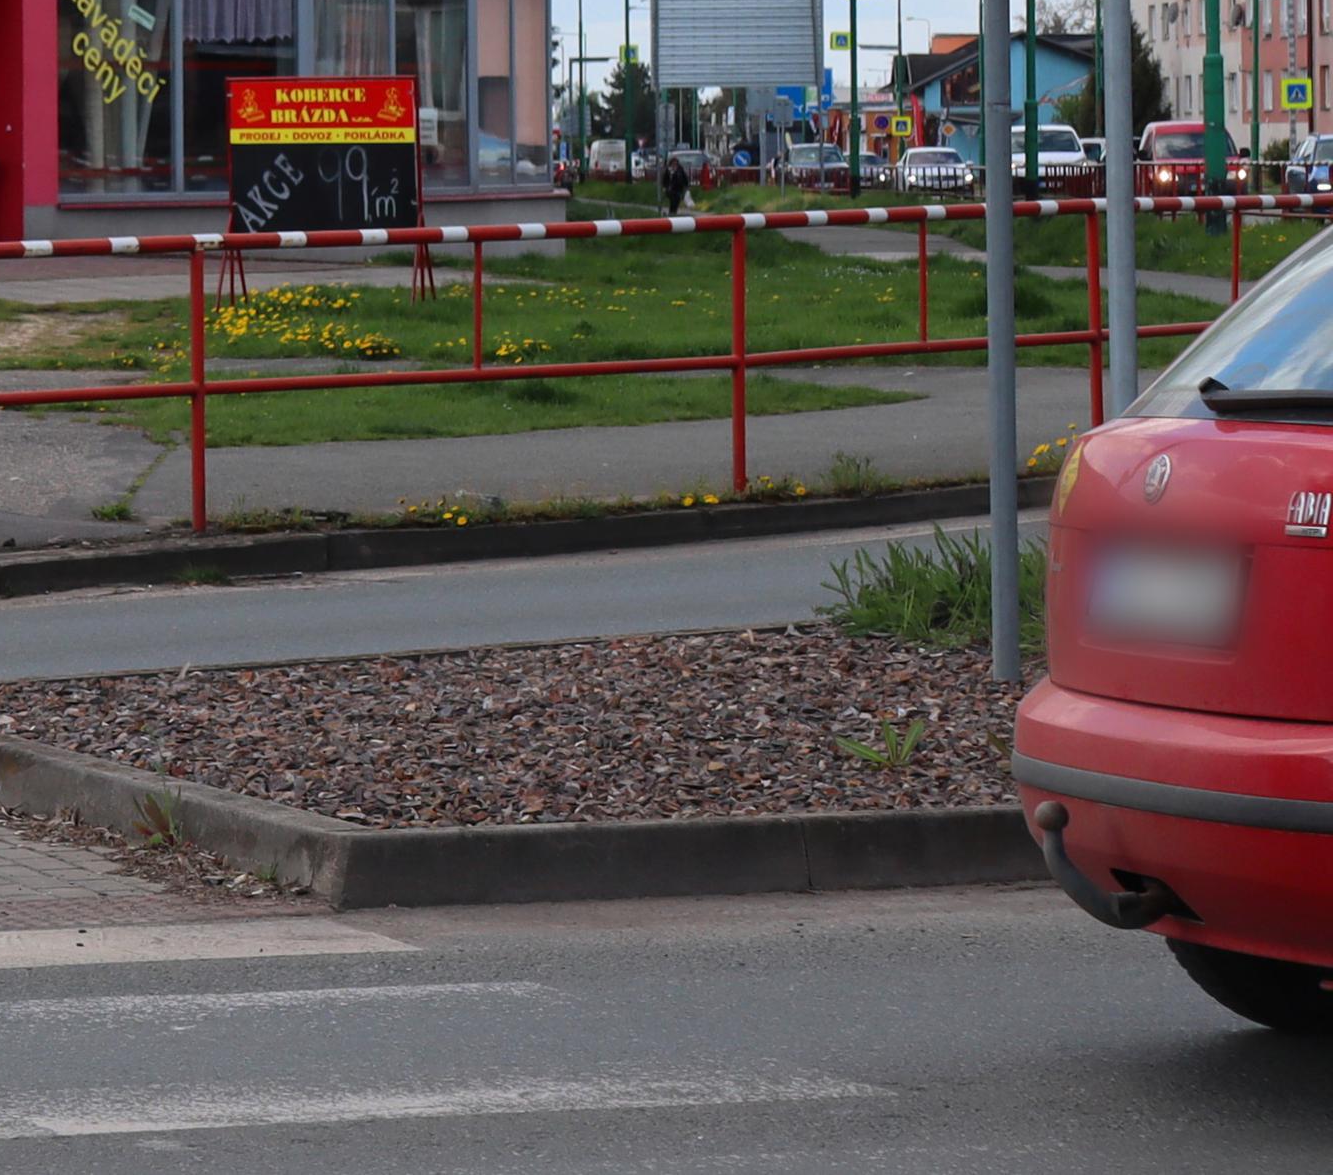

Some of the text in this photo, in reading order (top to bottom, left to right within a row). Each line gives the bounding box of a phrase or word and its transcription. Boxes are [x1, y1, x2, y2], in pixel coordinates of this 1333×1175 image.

[72, 32, 127, 104] ceny
[275, 88, 366, 103] KOBERCE
[271, 105, 350, 123] BRÁZDA
[239, 129, 406, 141] PRODEJ DOVOZ POKLÁDKA
[235, 153, 304, 234] AKCE
